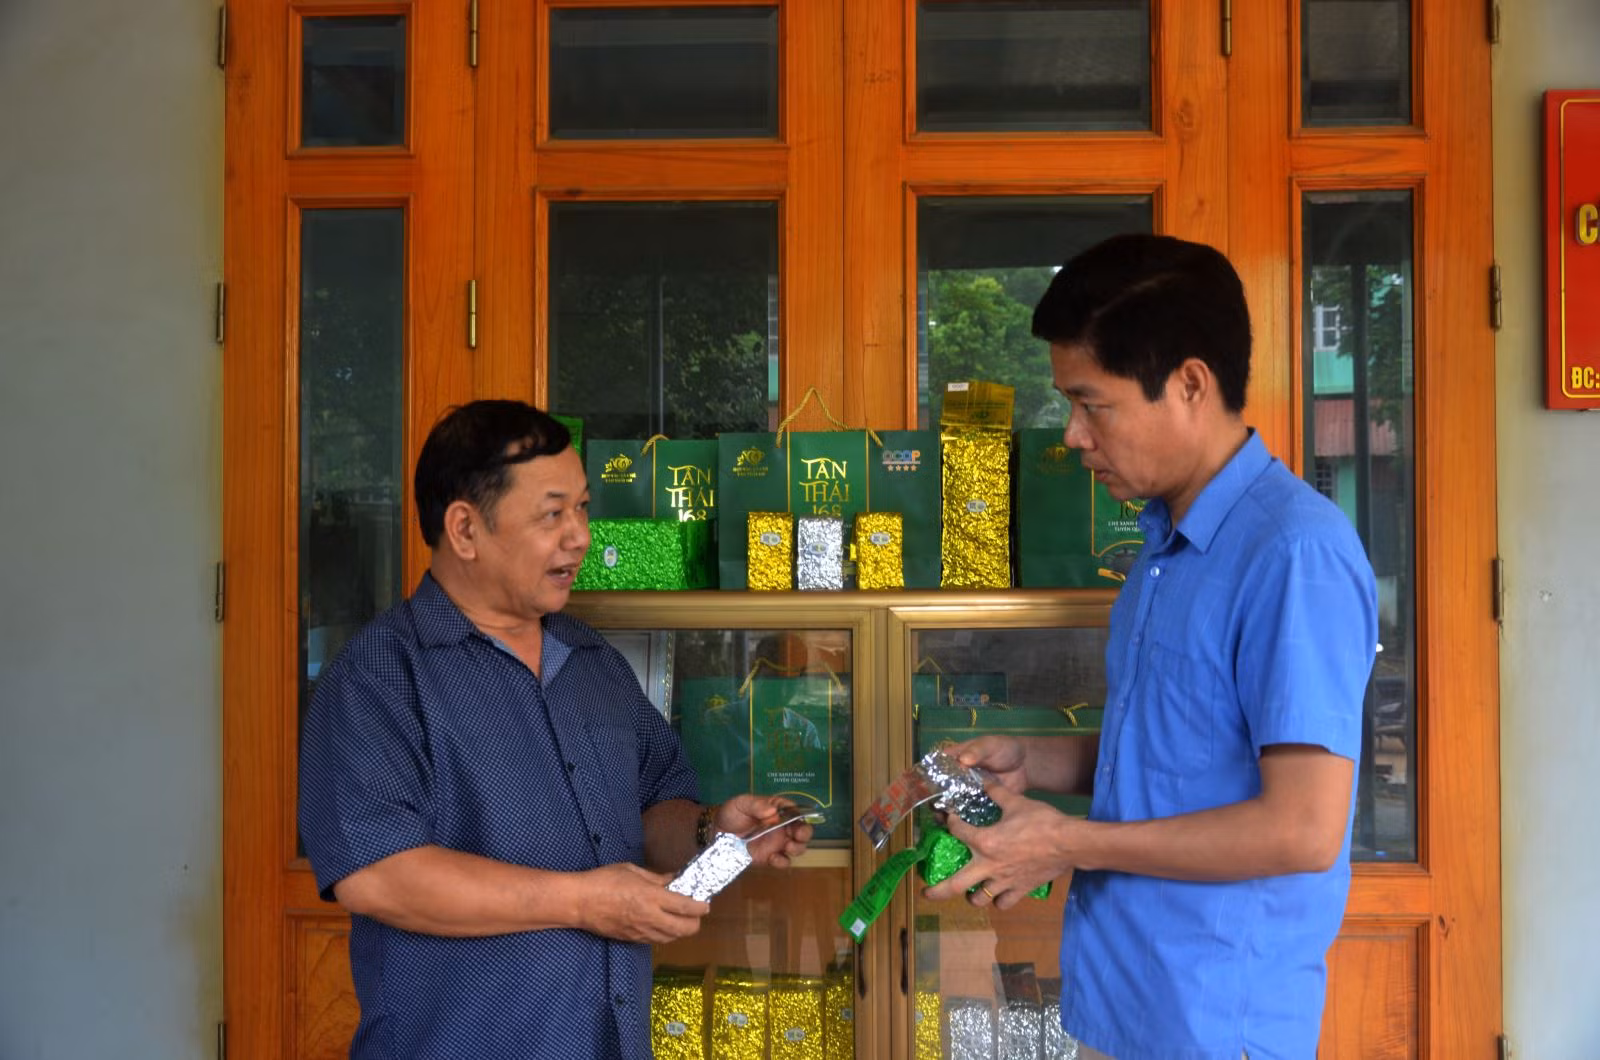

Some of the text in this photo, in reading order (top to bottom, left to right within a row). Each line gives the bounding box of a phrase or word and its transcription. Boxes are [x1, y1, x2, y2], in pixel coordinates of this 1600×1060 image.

[1571, 366, 1600, 389] ĐC:
[882, 449, 921, 462] OCOP
[665, 486, 714, 507] THÁI
[799, 480, 849, 502] THÁI
